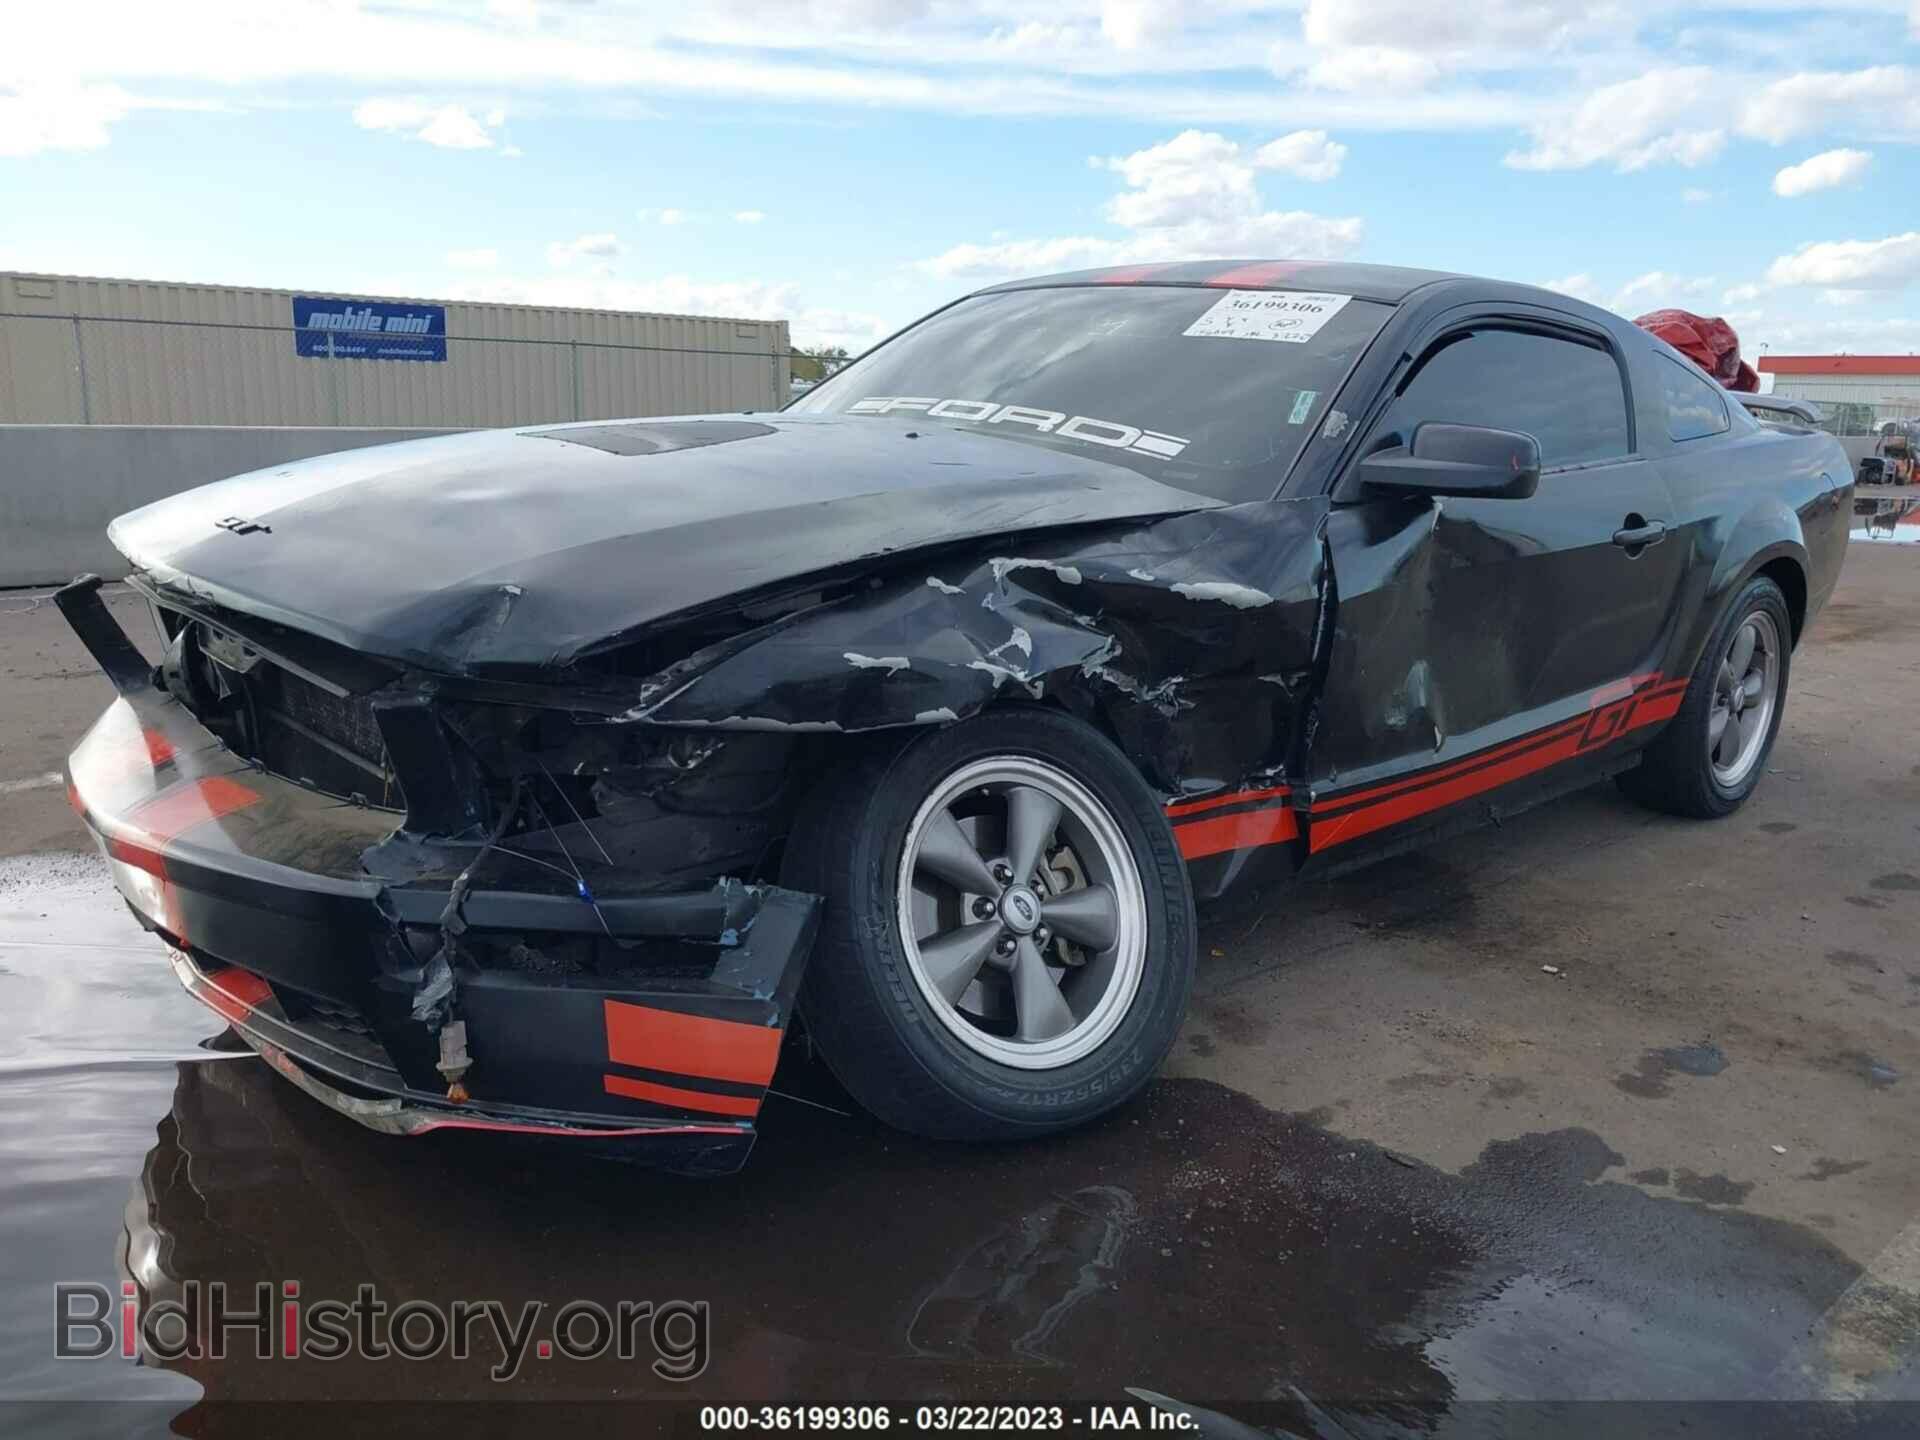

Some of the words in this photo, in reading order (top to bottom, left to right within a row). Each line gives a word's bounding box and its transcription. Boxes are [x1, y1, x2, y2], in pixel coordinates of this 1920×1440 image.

[307, 306, 382, 331] mobile
[385, 313, 432, 333] mini
[881, 397, 1144, 448] FORD
